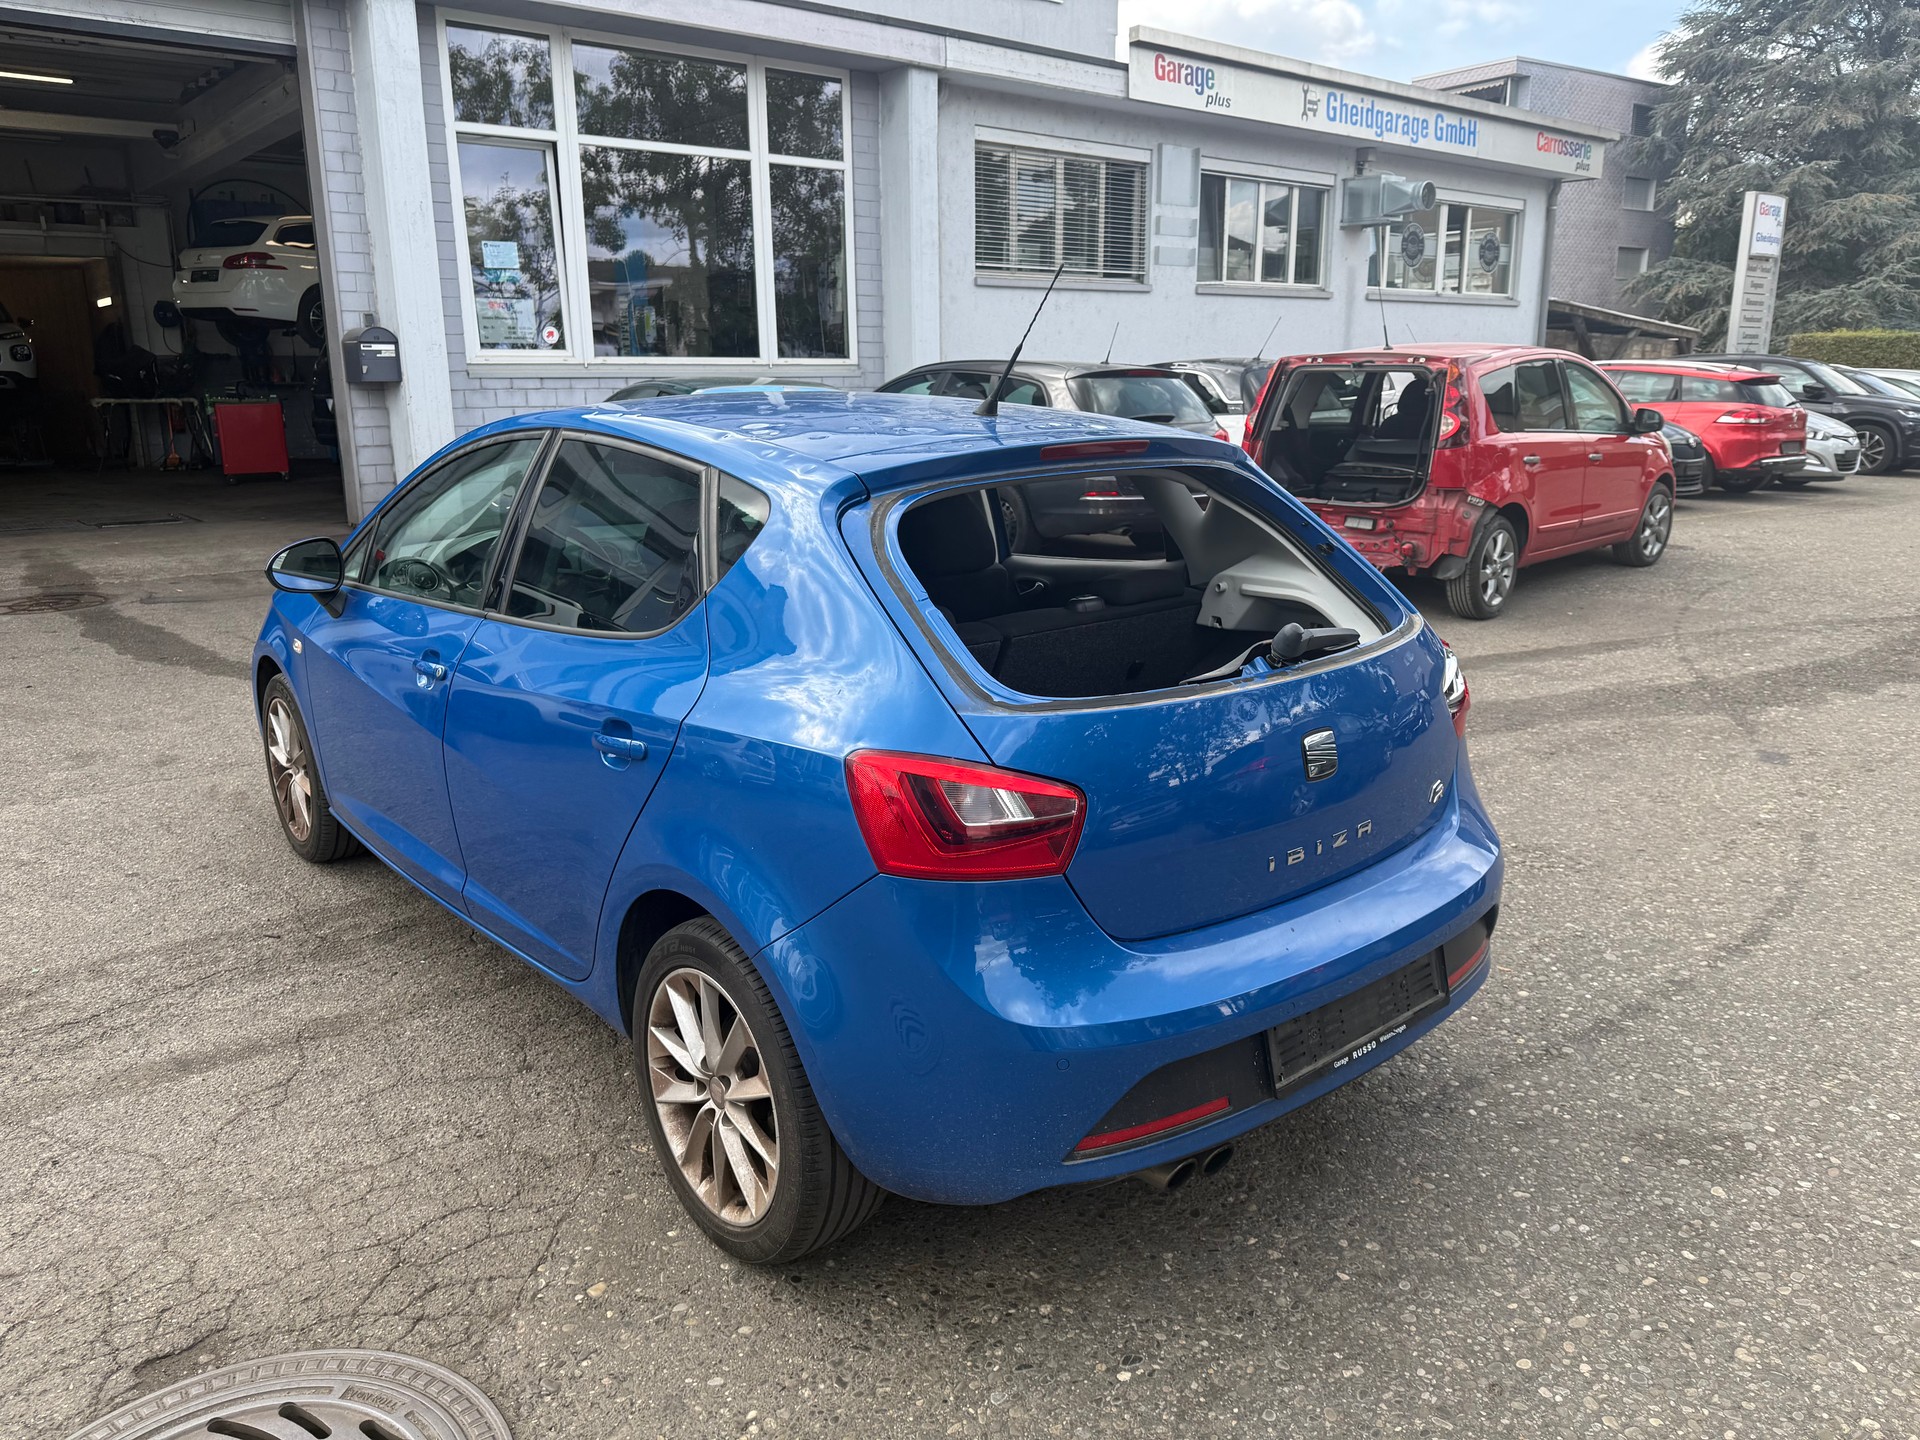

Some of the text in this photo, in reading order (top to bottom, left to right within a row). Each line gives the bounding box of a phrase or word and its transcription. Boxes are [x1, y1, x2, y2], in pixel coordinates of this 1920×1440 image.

[1154, 53, 1215, 96] Garage
[1205, 91, 1231, 108] plus
[1326, 91, 1478, 147] Gheidgarage GmbH
[1537, 131, 1592, 161] Carrosserie
[1575, 159, 1591, 172] plus
[1268, 819, 1372, 873] IBIZA
[1333, 1056, 1349, 1068] Garage
[1352, 1040, 1377, 1059] RUSSO
